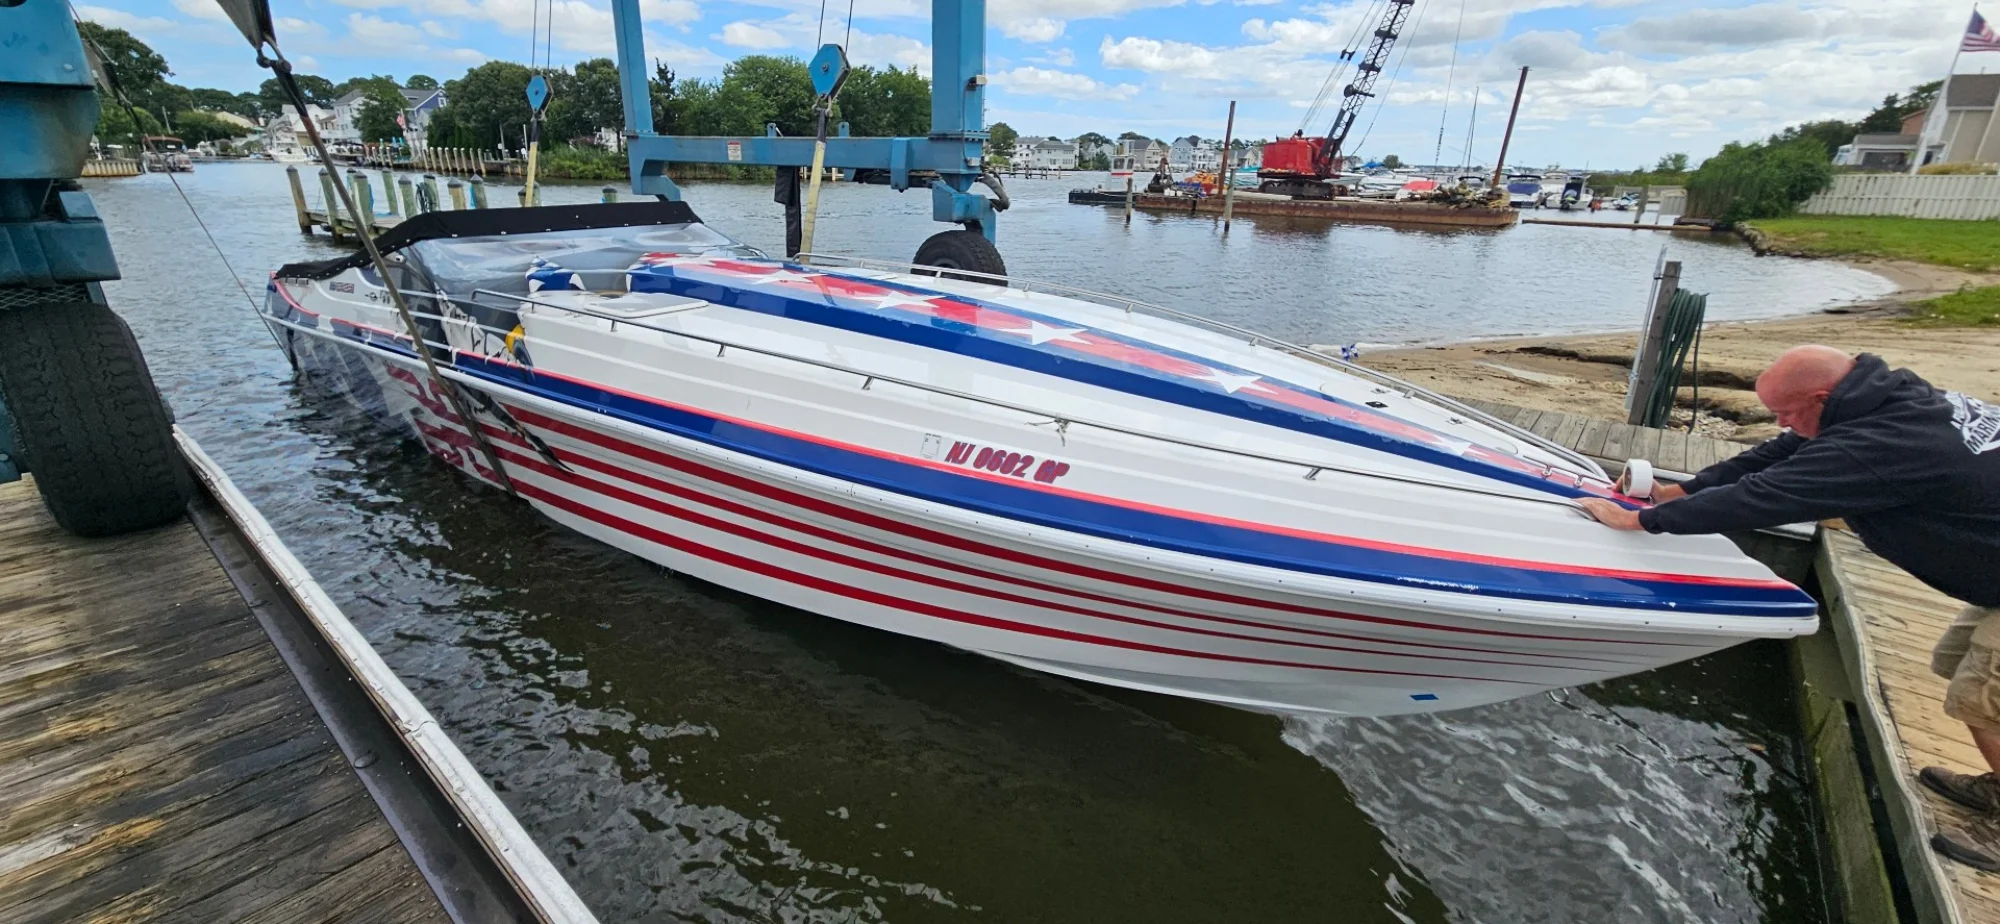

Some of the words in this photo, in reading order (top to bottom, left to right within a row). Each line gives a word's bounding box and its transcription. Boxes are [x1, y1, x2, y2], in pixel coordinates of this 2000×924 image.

[1966, 414, 2000, 452] MARIN
[944, 441, 976, 465] NJ
[973, 447, 1035, 478] 0602
